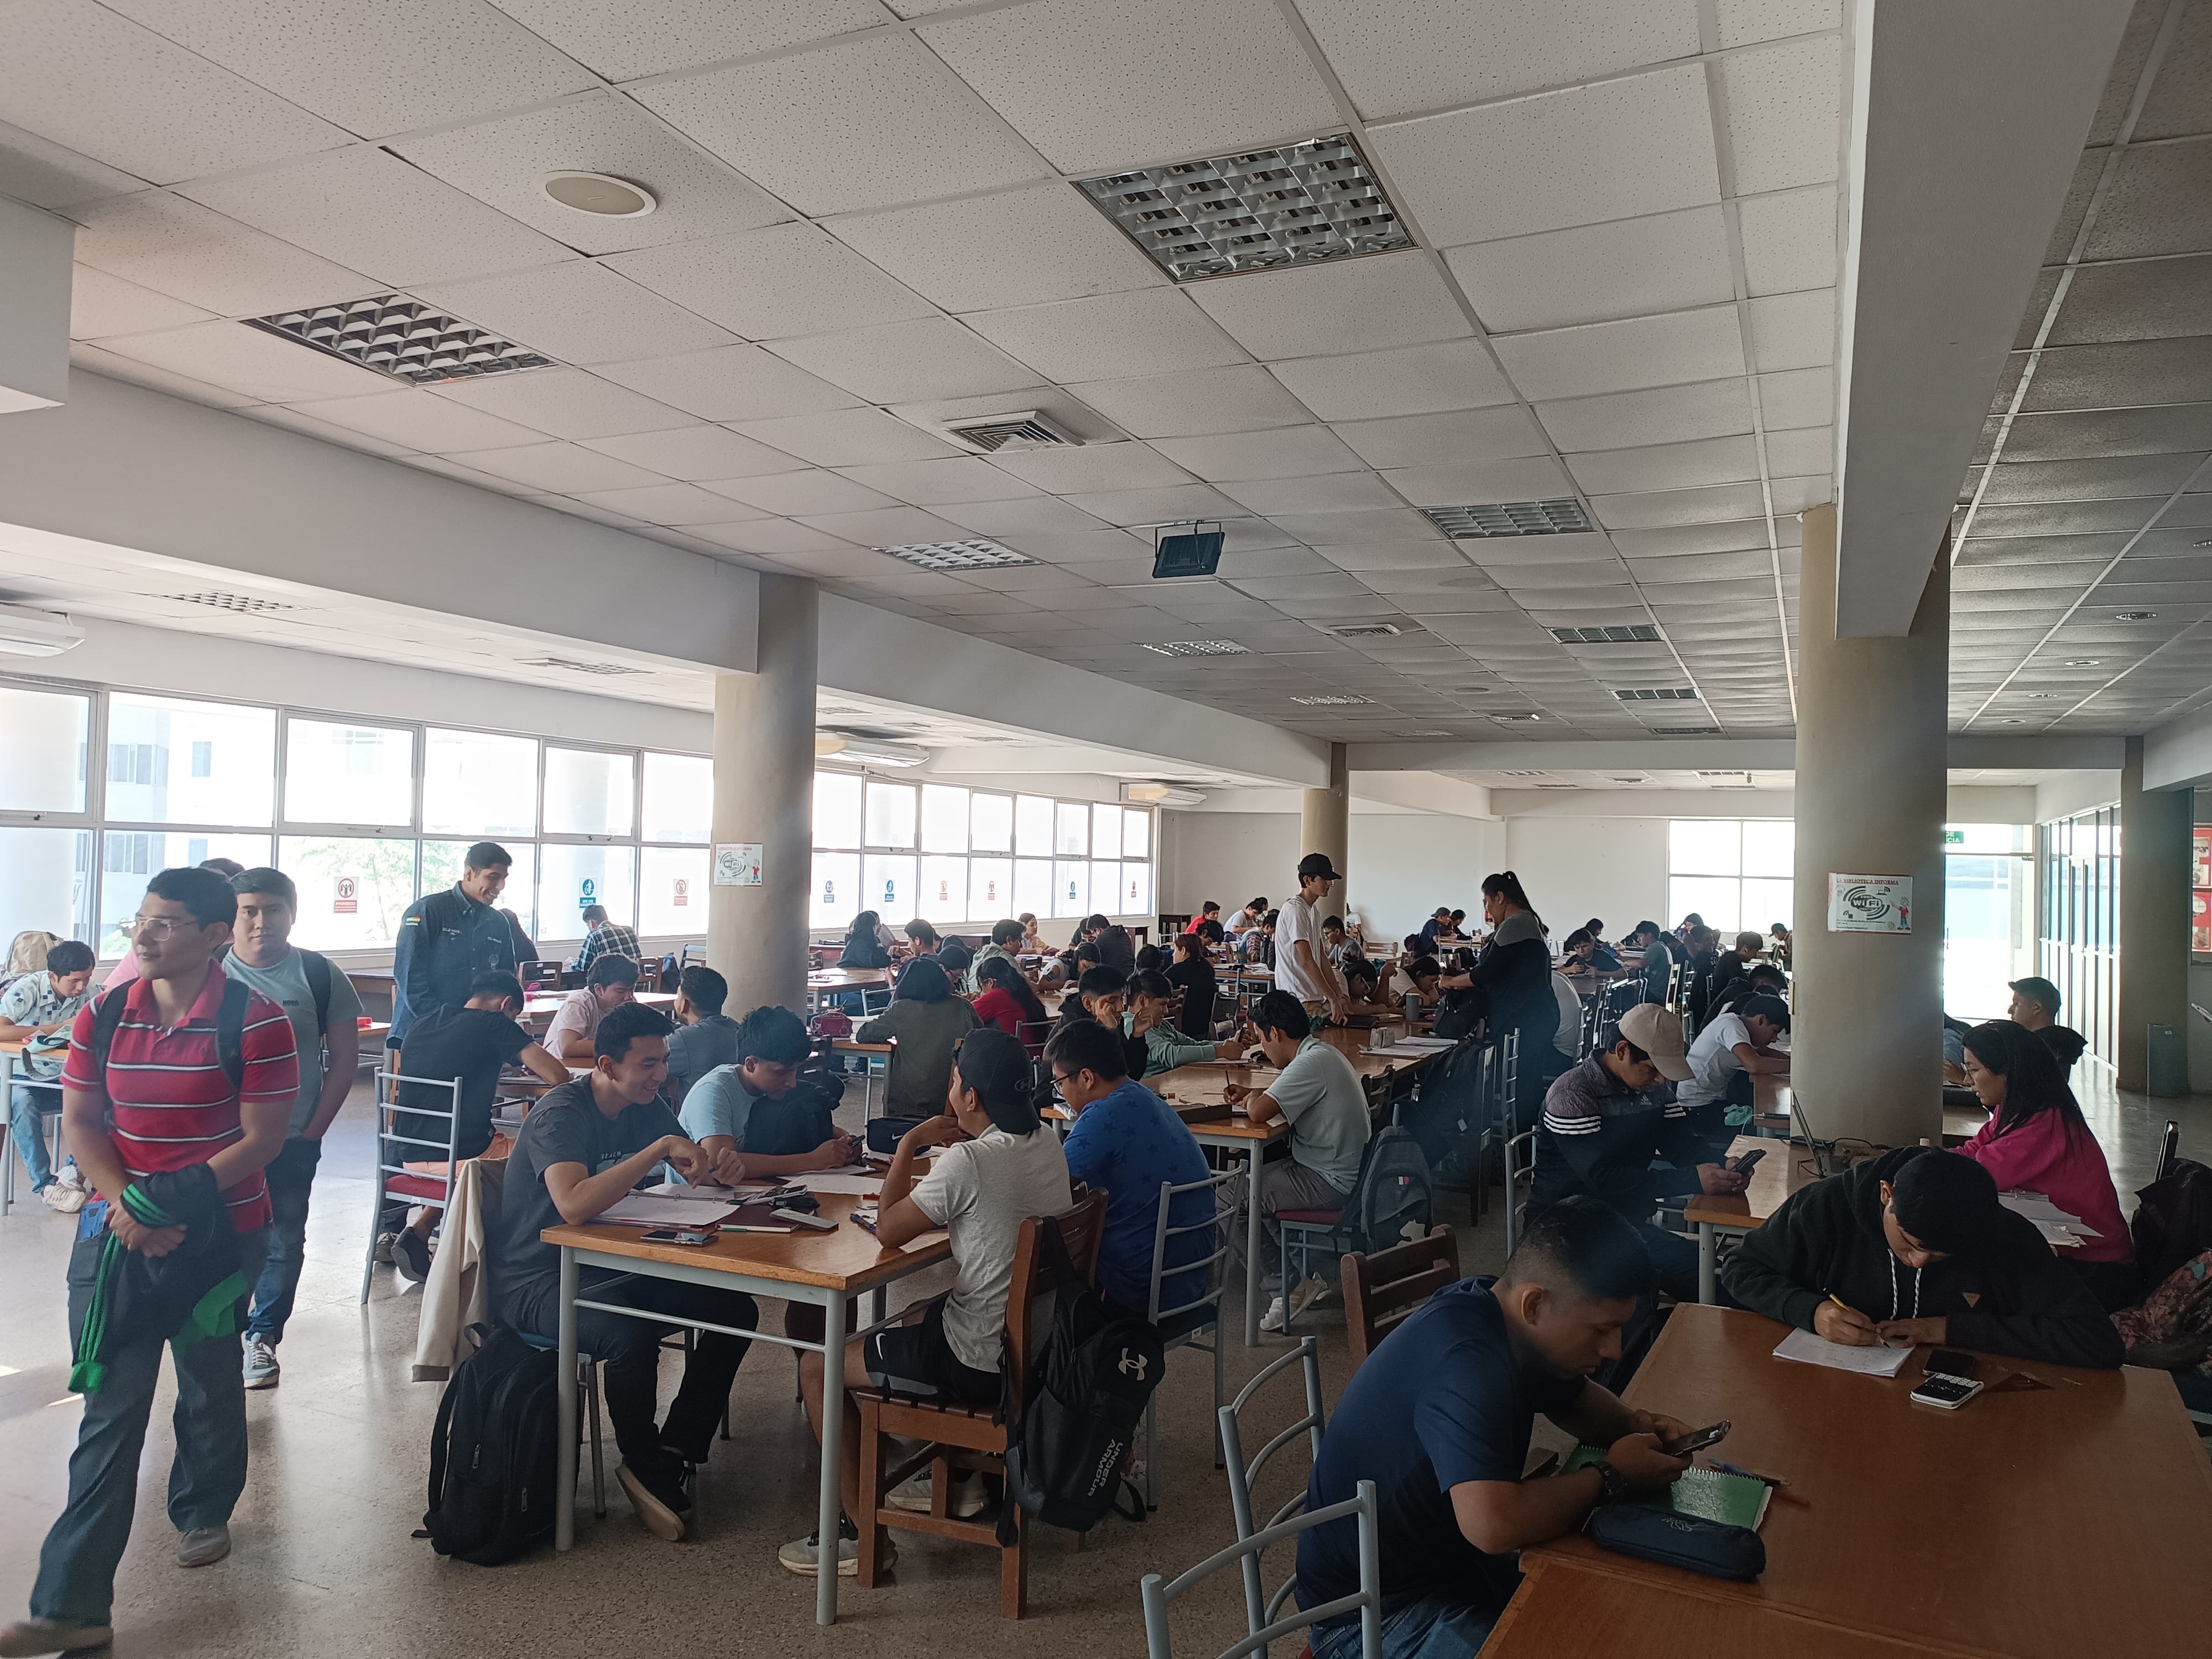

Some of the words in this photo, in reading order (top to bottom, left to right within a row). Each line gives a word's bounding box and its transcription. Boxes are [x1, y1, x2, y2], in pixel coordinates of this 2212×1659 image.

[601, 1151, 621, 1159] BEACH
[1087, 1438, 1116, 1496] ARMOUR
[1099, 1442, 1123, 1486] UNDER
